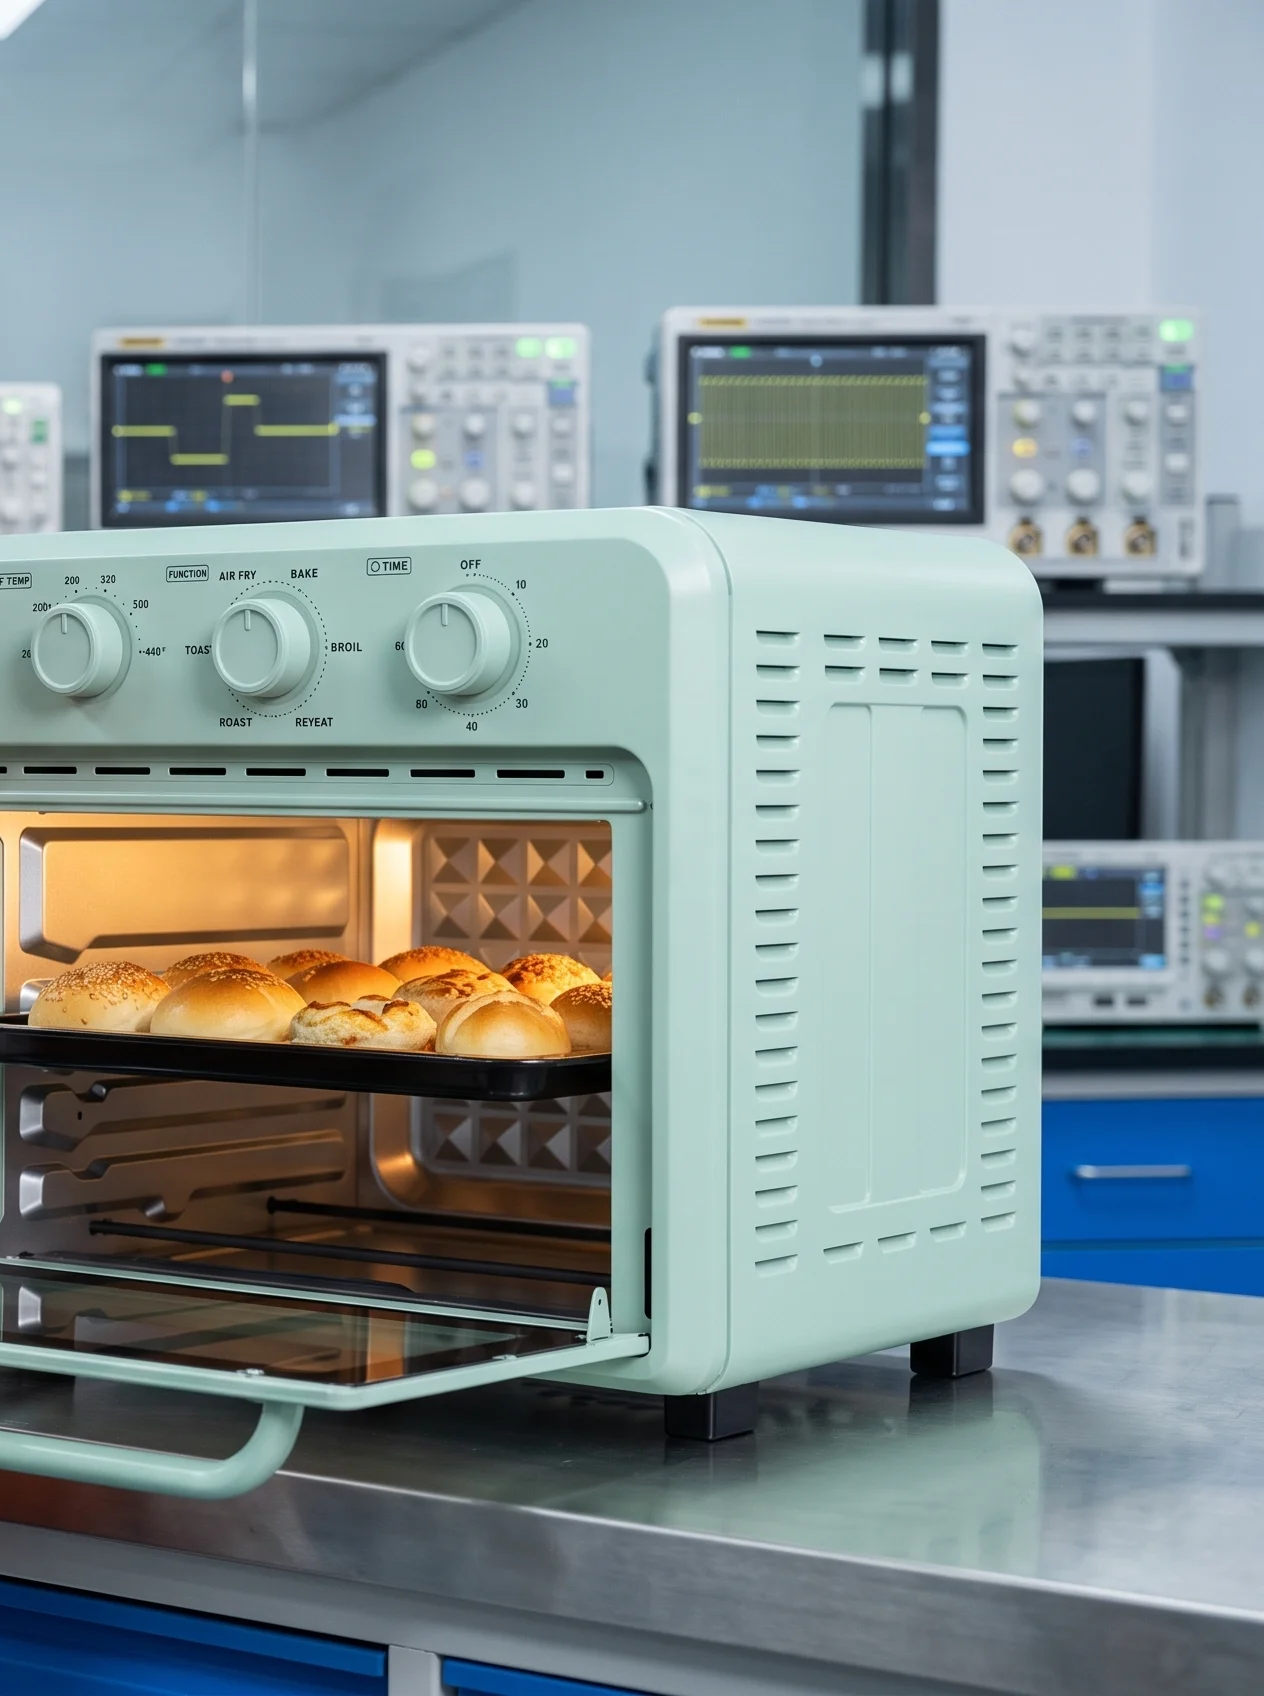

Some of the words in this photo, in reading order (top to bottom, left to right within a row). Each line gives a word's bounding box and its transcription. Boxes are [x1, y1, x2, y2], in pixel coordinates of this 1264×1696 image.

[382, 560, 408, 571] TIME
[460, 559, 482, 571] OFF
[168, 568, 207, 579] FUNCTION
[218, 571, 236, 582] AIR
[238, 569, 257, 580] FRY
[290, 567, 319, 579] BAKE
[6, 576, 30, 586] TEMP
[64, 575, 80, 586] 200
[100, 574, 116, 585] 320
[515, 579, 527, 590] 10
[132, 599, 149, 610] 500
[330, 641, 363, 653] BROIL
[535, 638, 549, 649] 20
[184, 644, 213, 656] TOAS
[515, 698, 529, 709] 30
[219, 717, 253, 728] ROAST
[295, 716, 334, 728] REYEAT
[465, 720, 478, 732] 40
